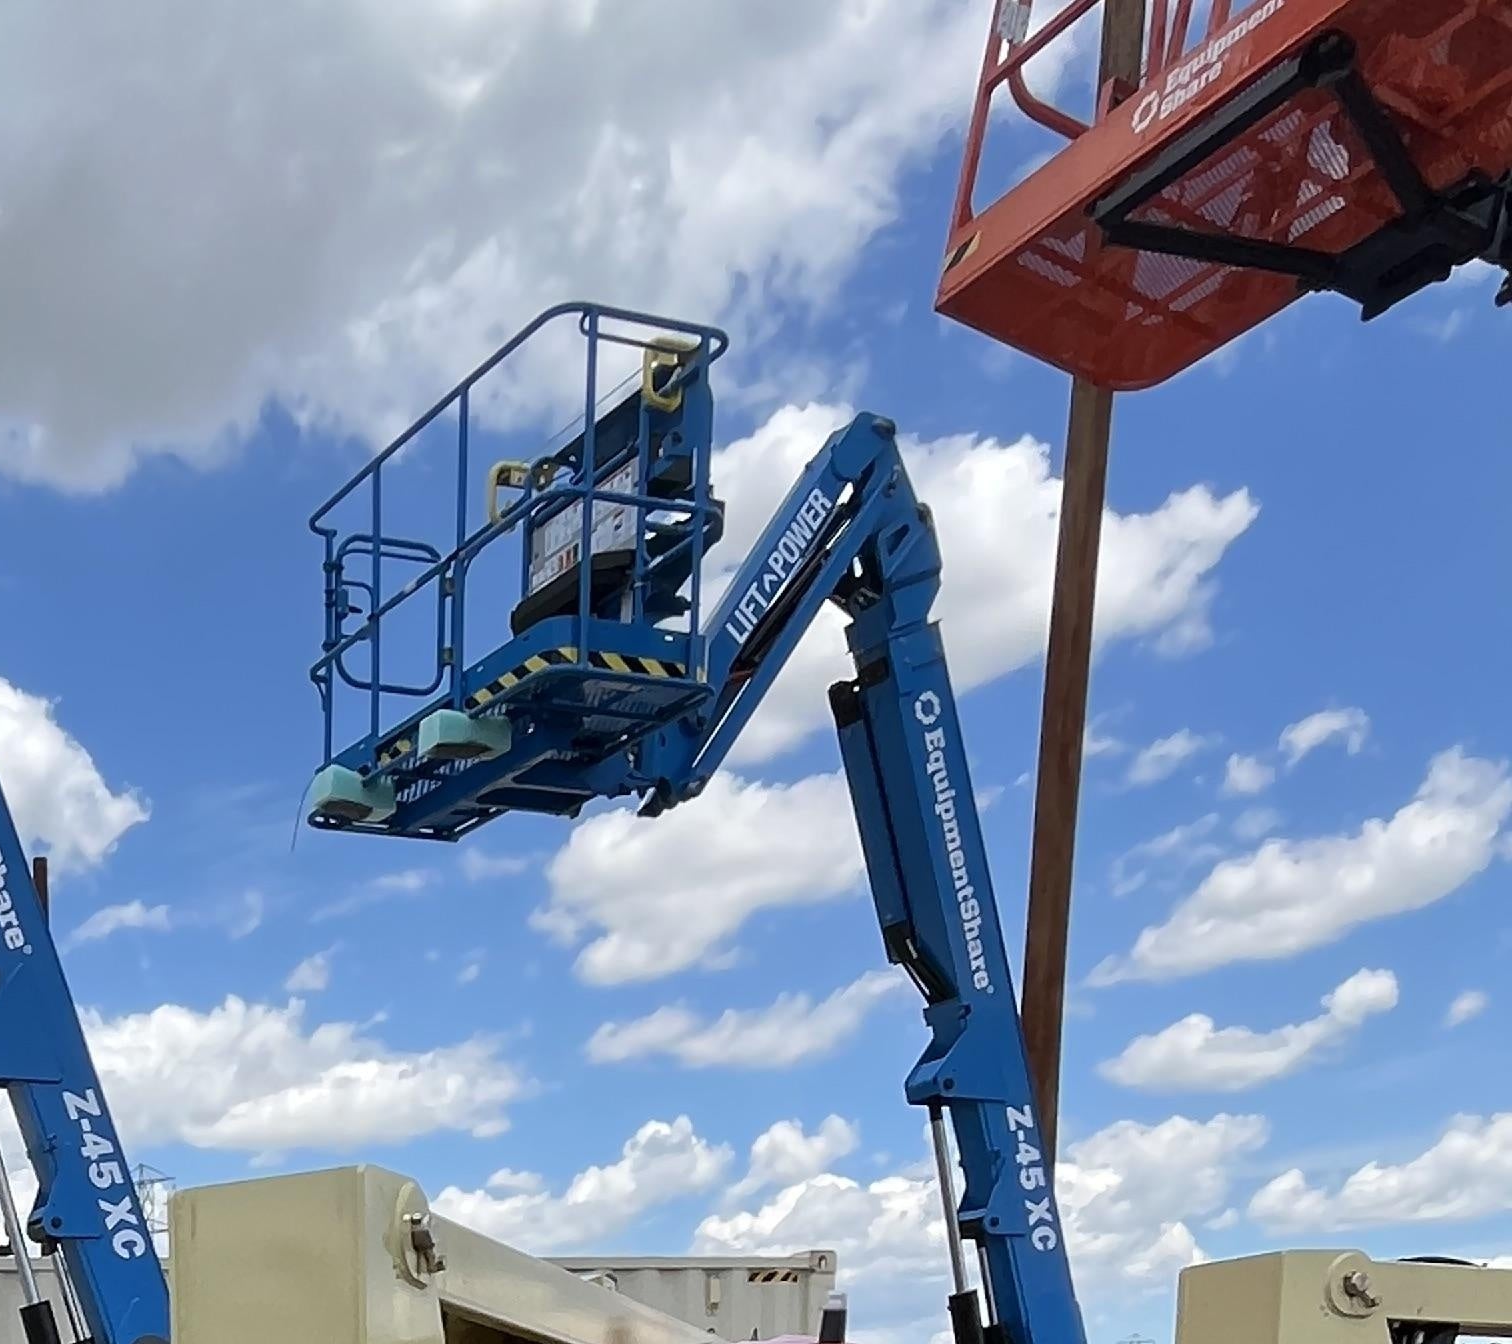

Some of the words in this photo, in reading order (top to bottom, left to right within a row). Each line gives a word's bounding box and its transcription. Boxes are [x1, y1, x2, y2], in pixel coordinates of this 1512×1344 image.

[725, 581, 768, 644] LIFT
[768, 488, 832, 579] POWER
[924, 726, 991, 994] EquipmentShare
[62, 1088, 124, 1189] Z-45
[98, 1196, 146, 1259] XC
[1006, 1104, 1045, 1194] Z-45
[1025, 1197, 1057, 1253] XC
